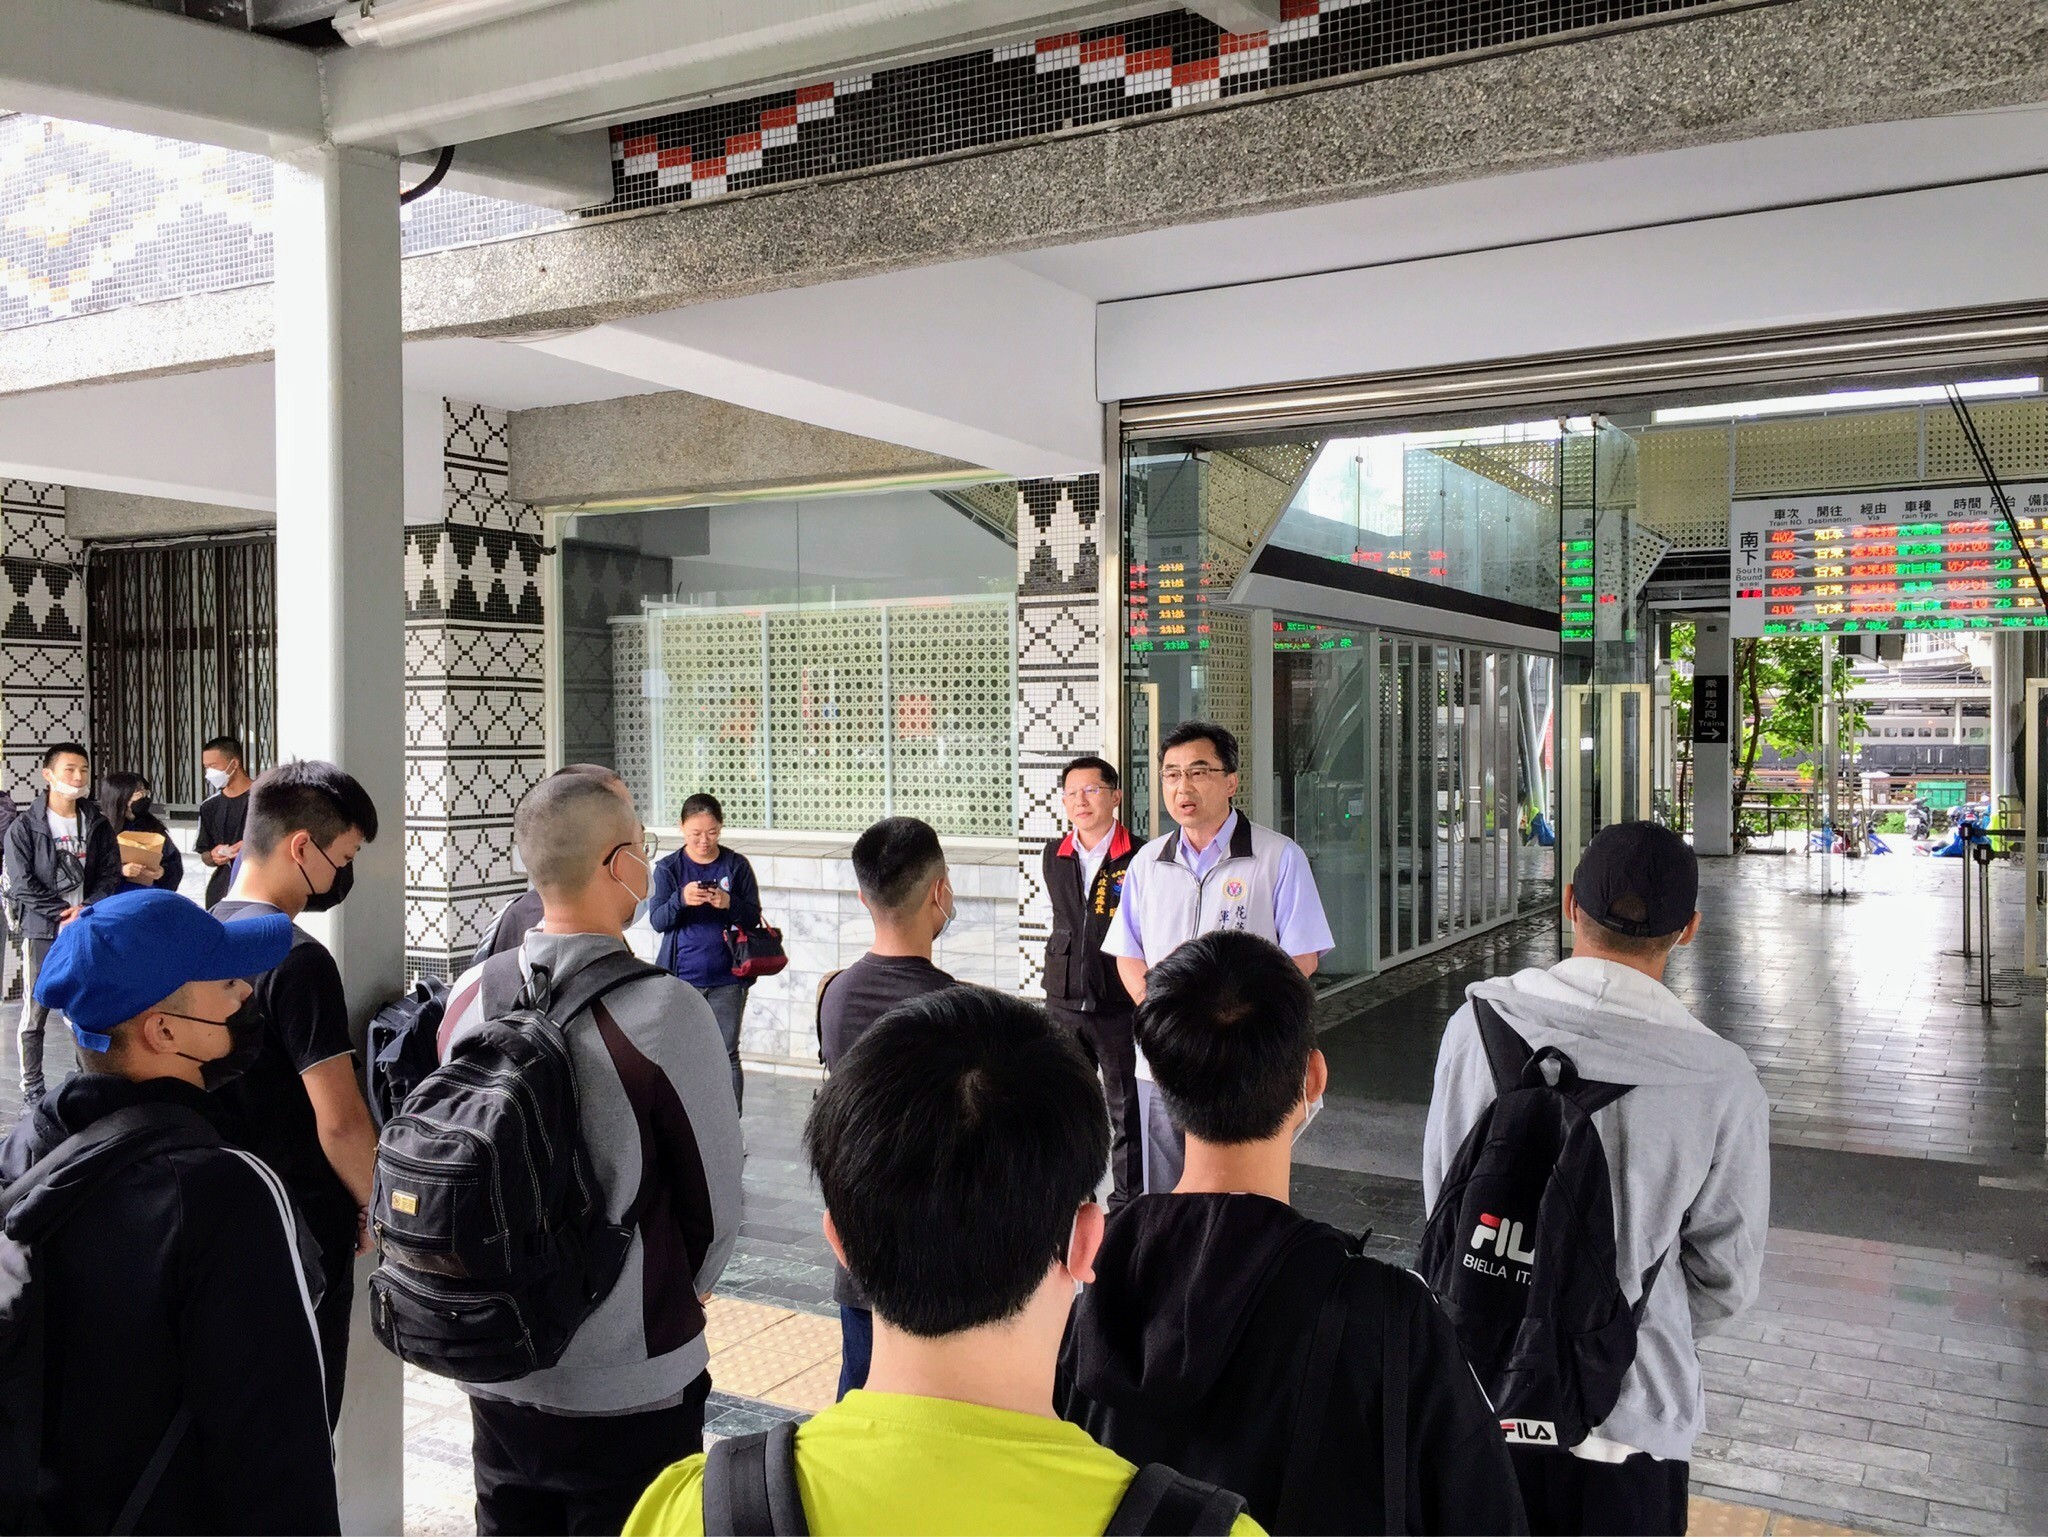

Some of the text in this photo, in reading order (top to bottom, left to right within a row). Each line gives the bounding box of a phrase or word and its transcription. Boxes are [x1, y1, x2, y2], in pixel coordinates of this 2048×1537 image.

[1774, 508, 1800, 520] 車次
[1816, 505, 1843, 517] 開往
[1860, 502, 1887, 515] 經由
[1904, 499, 1932, 513] 車種
[1953, 497, 1982, 510] 時間
[1968, 509, 1989, 517] Time
[1807, 516, 1852, 525] Destination
[1919, 511, 1939, 520] Type
[1739, 531, 1760, 566] 南下
[1736, 566, 1763, 574] South
[1735, 573, 1763, 582] Bound
[1865, 618, 1890, 631] 402
[1470, 1212, 1536, 1266] FIL
[1462, 1252, 1507, 1280] BIELLA
[1500, 1421, 1553, 1441] FILA
